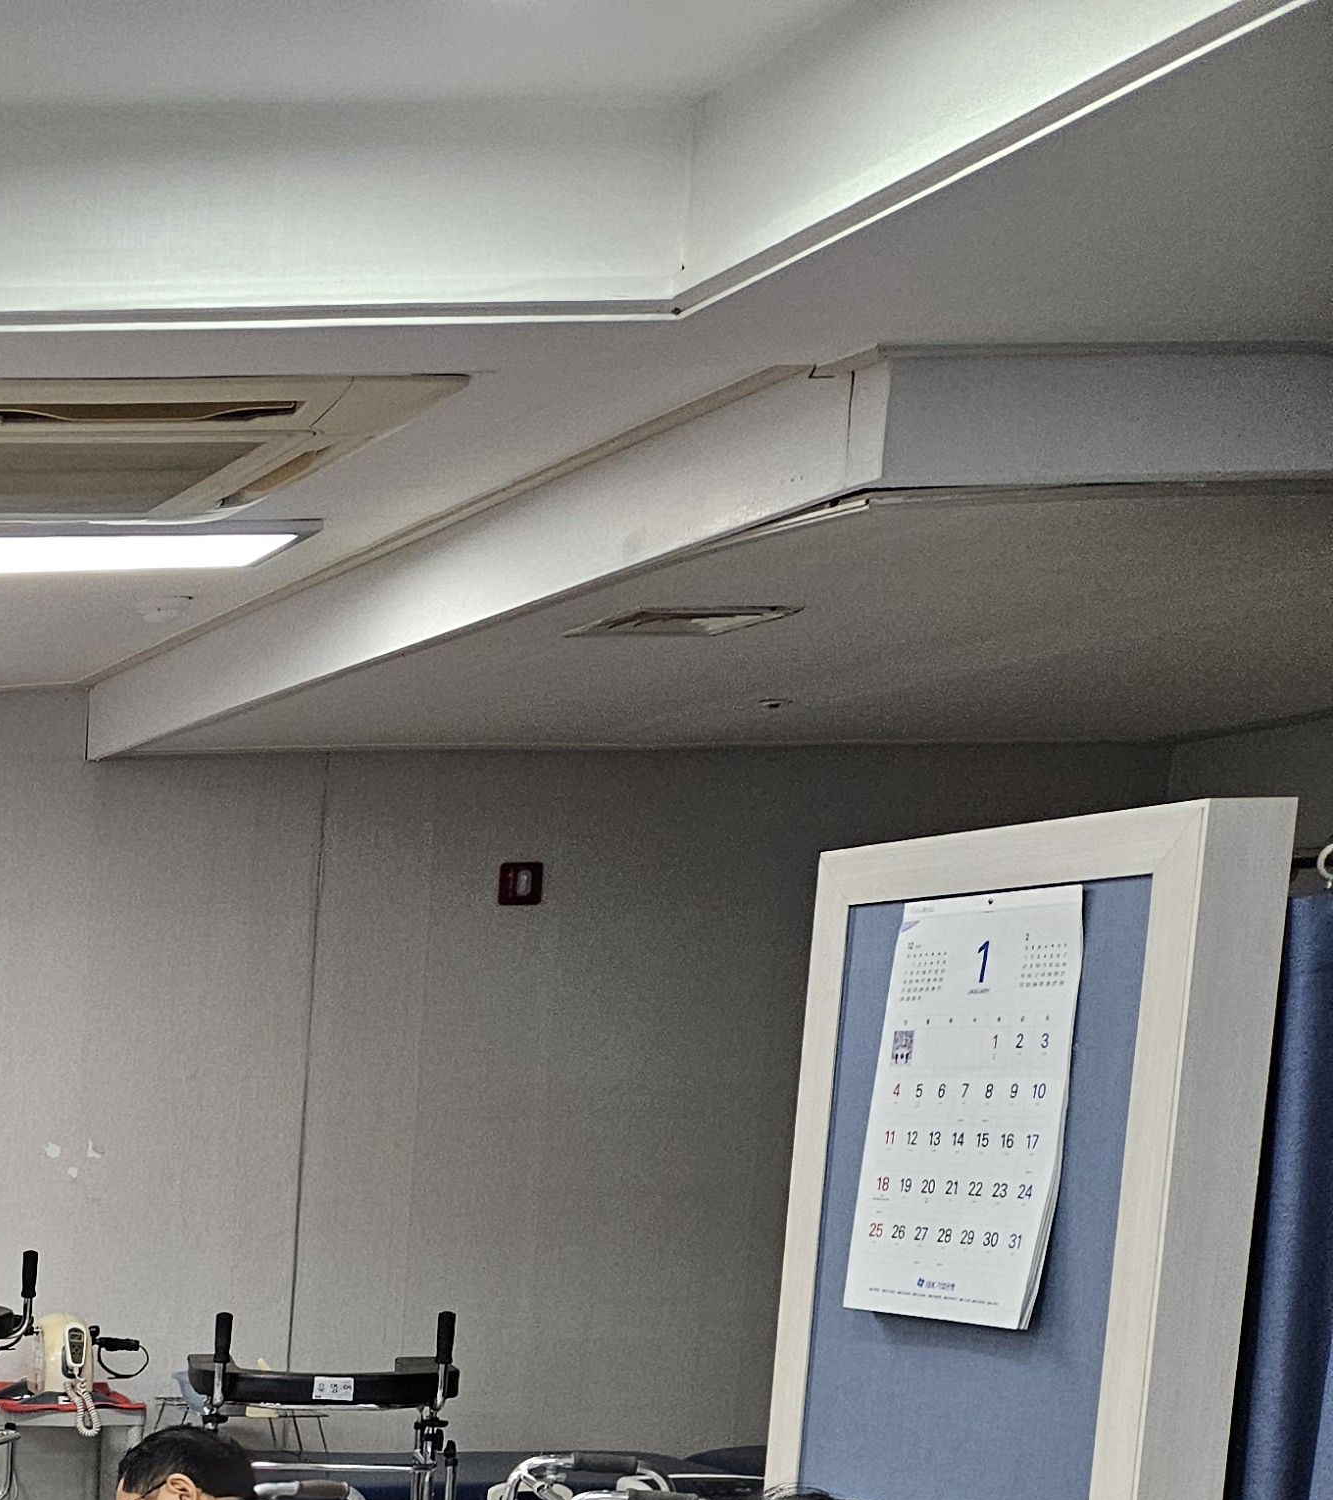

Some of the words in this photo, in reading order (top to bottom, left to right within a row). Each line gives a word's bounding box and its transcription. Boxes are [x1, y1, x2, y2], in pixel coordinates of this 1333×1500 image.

[977, 940, 990, 983] 1
[993, 1034, 999, 1049] 1
[1015, 1033, 1024, 1048] 2
[1041, 1032, 1049, 1048] 3
[893, 1083, 901, 1097] 4
[915, 1084, 923, 1098] 5
[938, 1084, 946, 1098] 6
[961, 1084, 969, 1098] 7
[985, 1084, 993, 1098] 8
[1010, 1083, 1018, 1098] 9
[1033, 1083, 1046, 1098] 10
[885, 1130, 895, 1144] 11
[907, 1131, 918, 1146] 12
[929, 1131, 941, 1146] 13
[952, 1132, 964, 1146] 14
[976, 1133, 989, 1148] 15
[1001, 1133, 1014, 1149] 16
[1027, 1134, 1039, 1149] 17
[877, 1177, 889, 1191] 18
[900, 1178, 912, 1192] 19
[921, 1179, 935, 1194] 20
[945, 1180, 958, 1195] 21
[968, 1182, 983, 1196] 22
[992, 1183, 1008, 1198] 23
[1017, 1184, 1033, 1199] 24
[869, 1223, 883, 1237] 25
[892, 1224, 906, 1239] 26
[914, 1226, 929, 1241] 27
[937, 1228, 952, 1243] 28
[960, 1230, 975, 1245] 29
[983, 1232, 999, 1247] 30
[1009, 1233, 1023, 1249] 31
